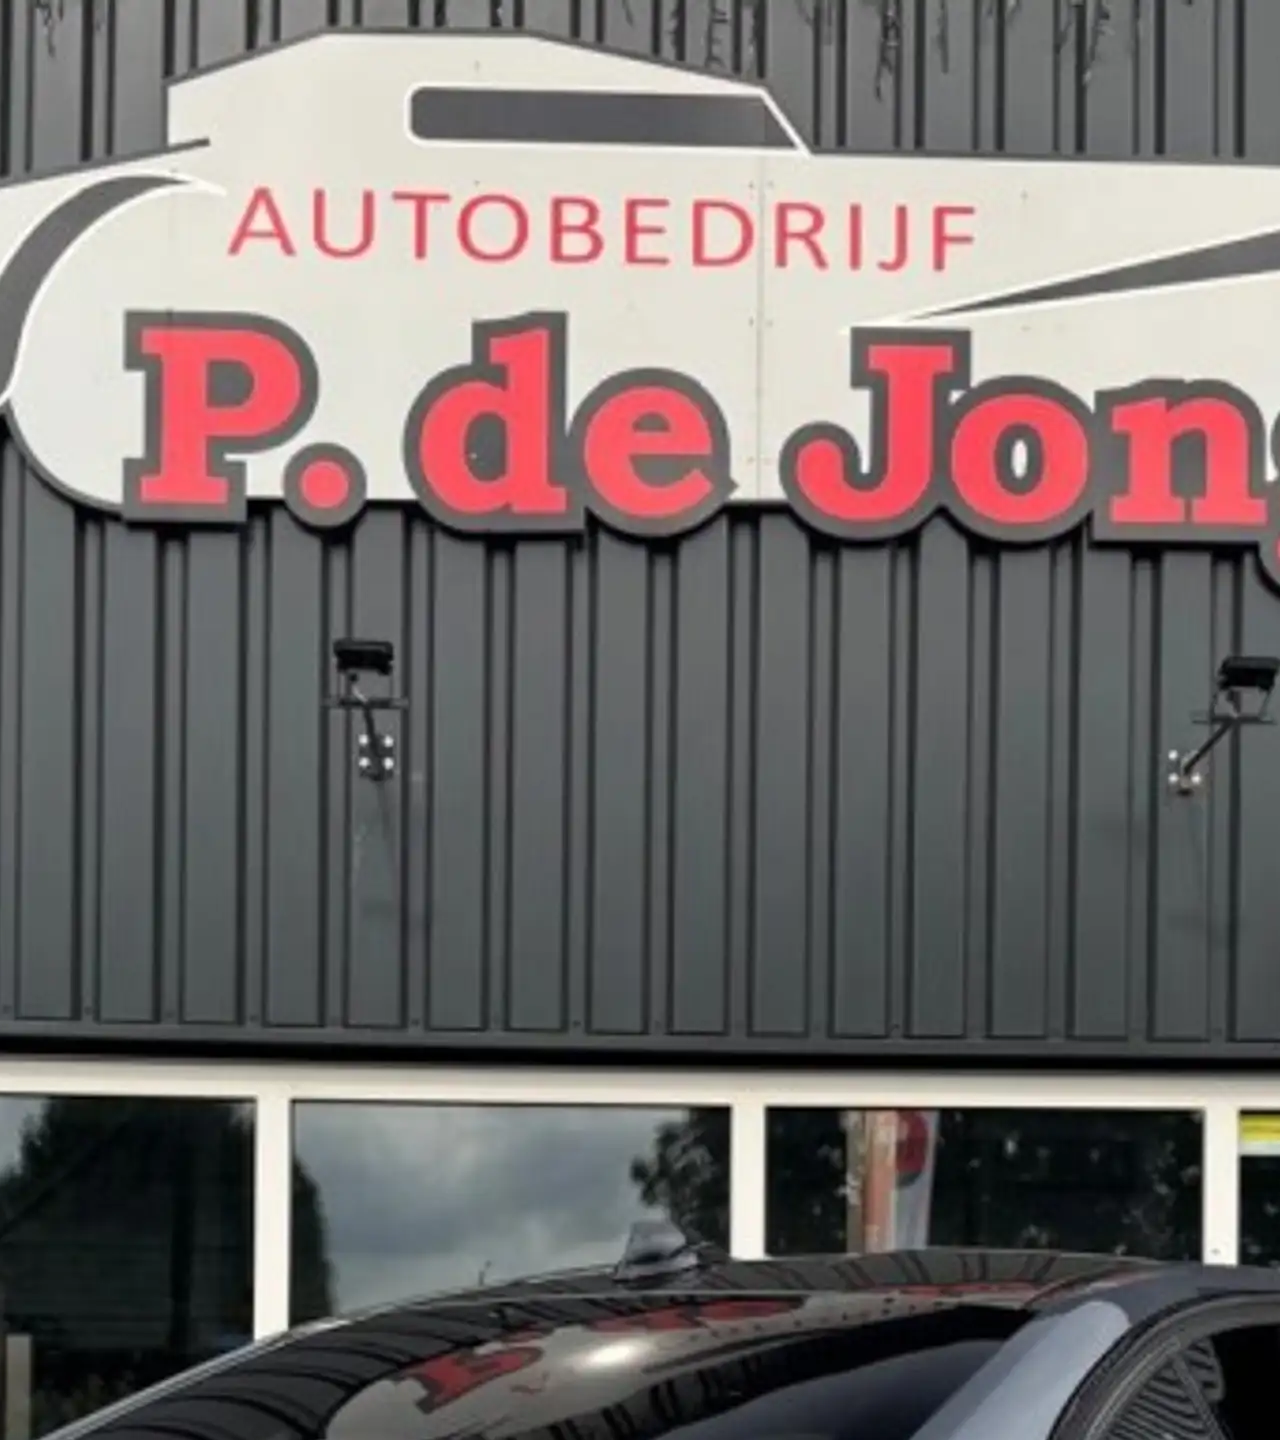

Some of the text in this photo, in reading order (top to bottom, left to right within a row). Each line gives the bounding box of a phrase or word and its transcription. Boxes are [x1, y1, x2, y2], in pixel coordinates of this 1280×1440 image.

[227, 187, 977, 273] AUTOBEDRIJF
[130, 316, 360, 520] P.
[410, 318, 725, 526] de
